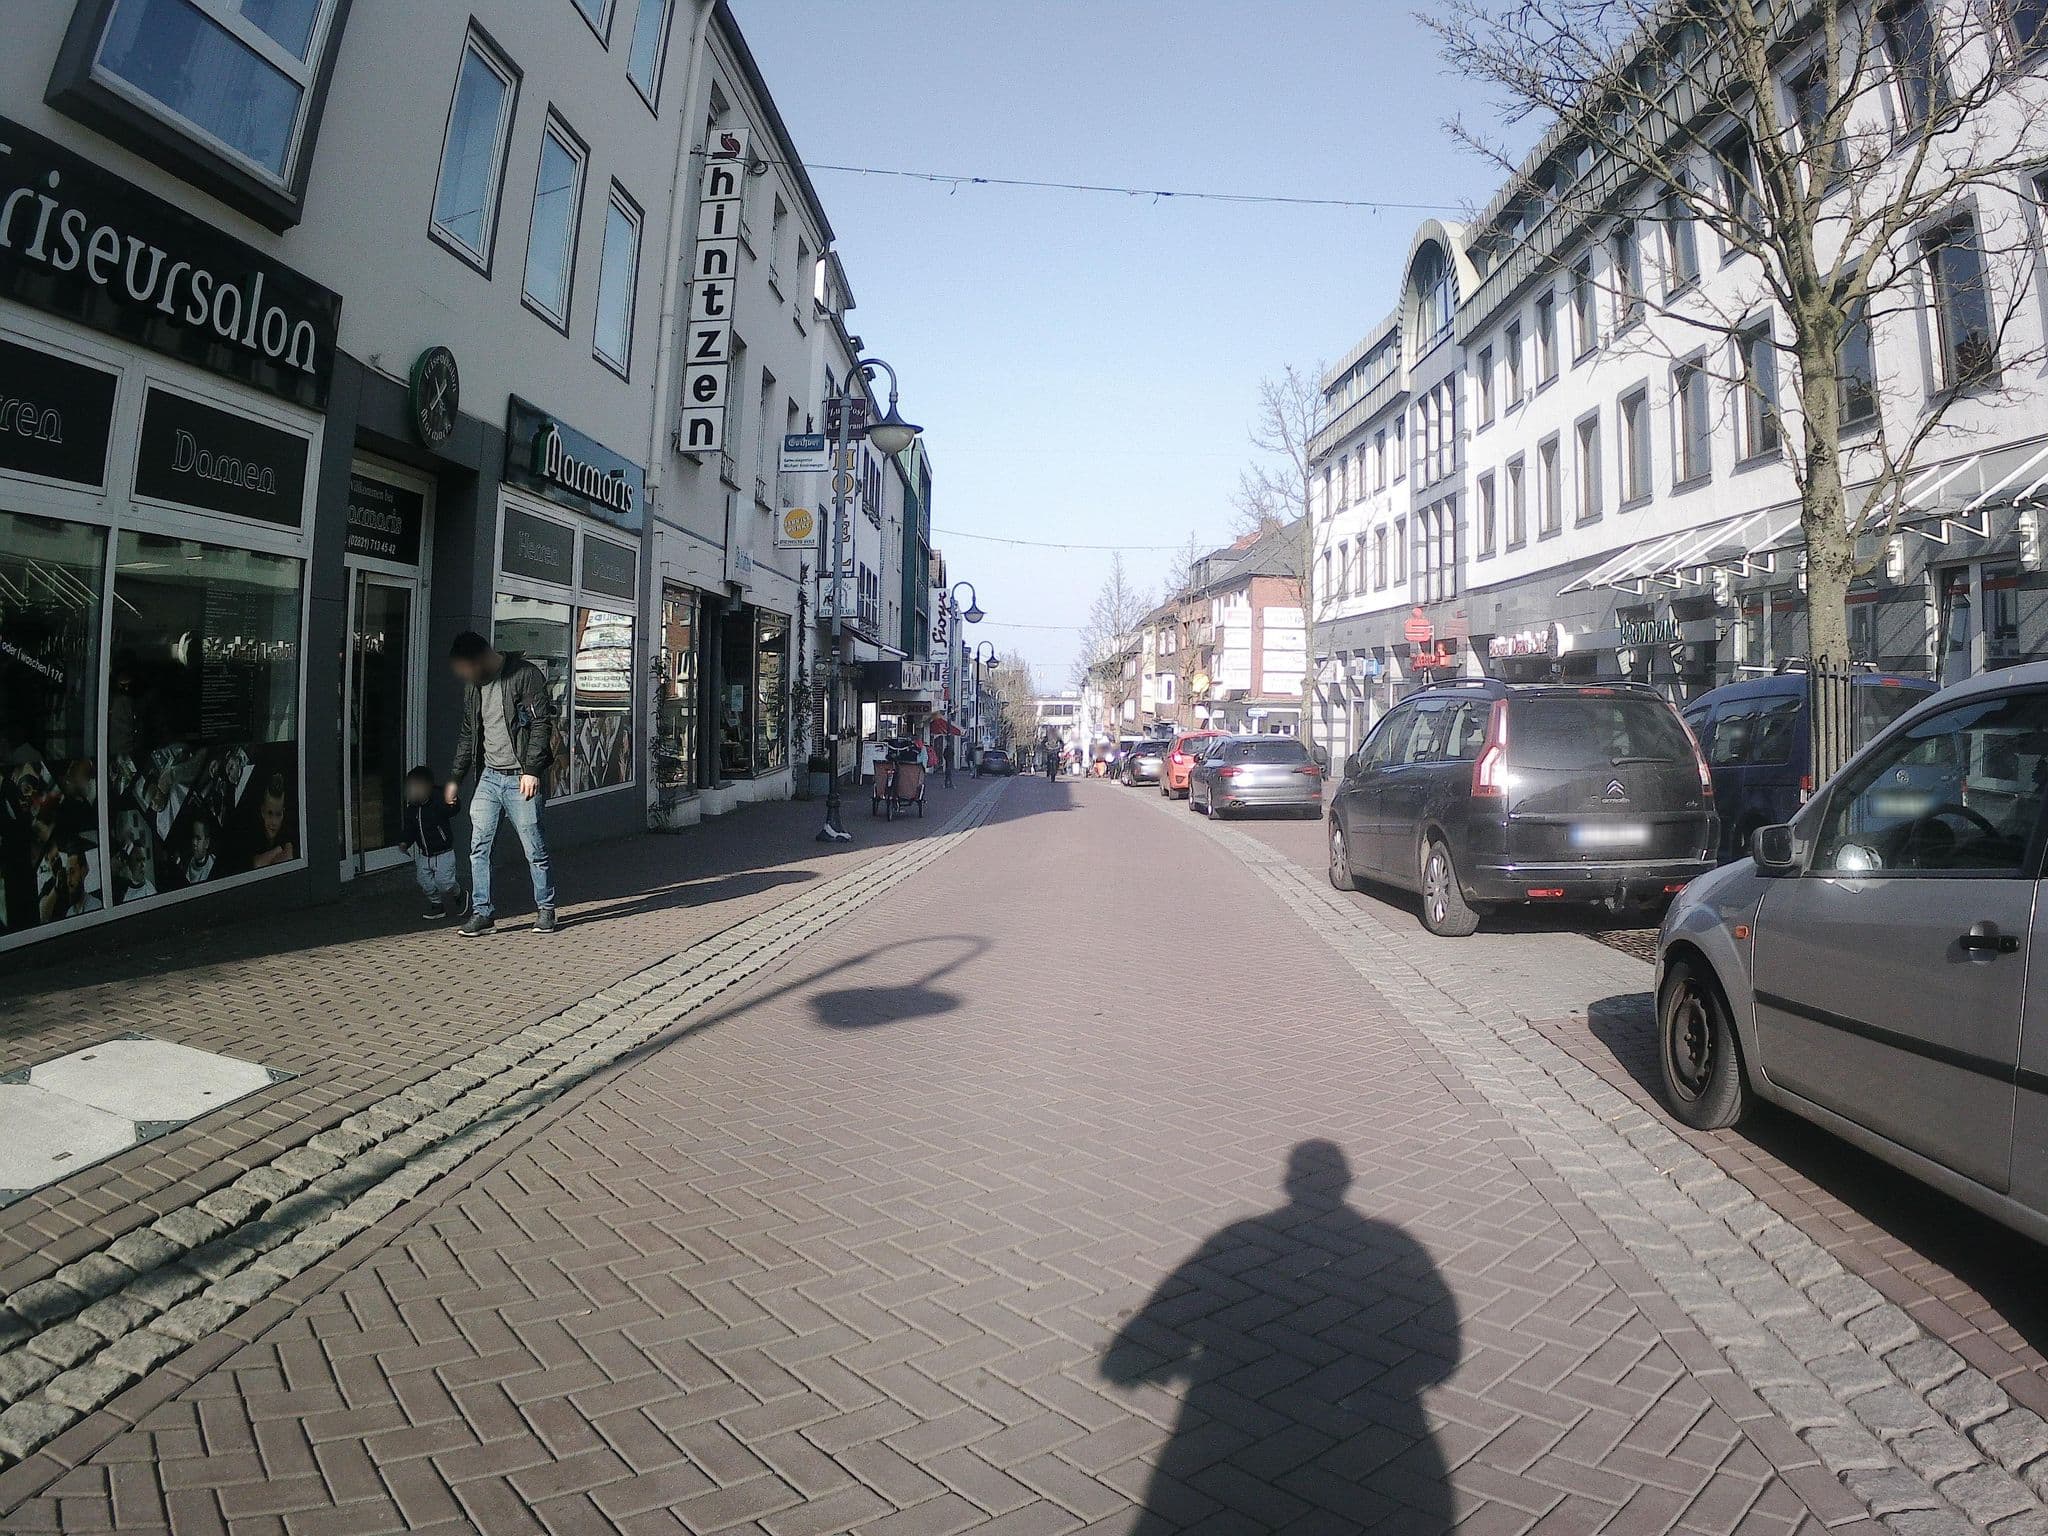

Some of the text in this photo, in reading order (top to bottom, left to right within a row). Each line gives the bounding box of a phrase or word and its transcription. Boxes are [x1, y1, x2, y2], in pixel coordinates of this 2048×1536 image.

[0, 143, 316, 375] riseursalon
[688, 167, 735, 447] hintzen
[0, 395, 63, 444] ren
[171, 430, 277, 495] Damen
[543, 422, 635, 513] Marmaris
[347, 504, 403, 535] armaris
